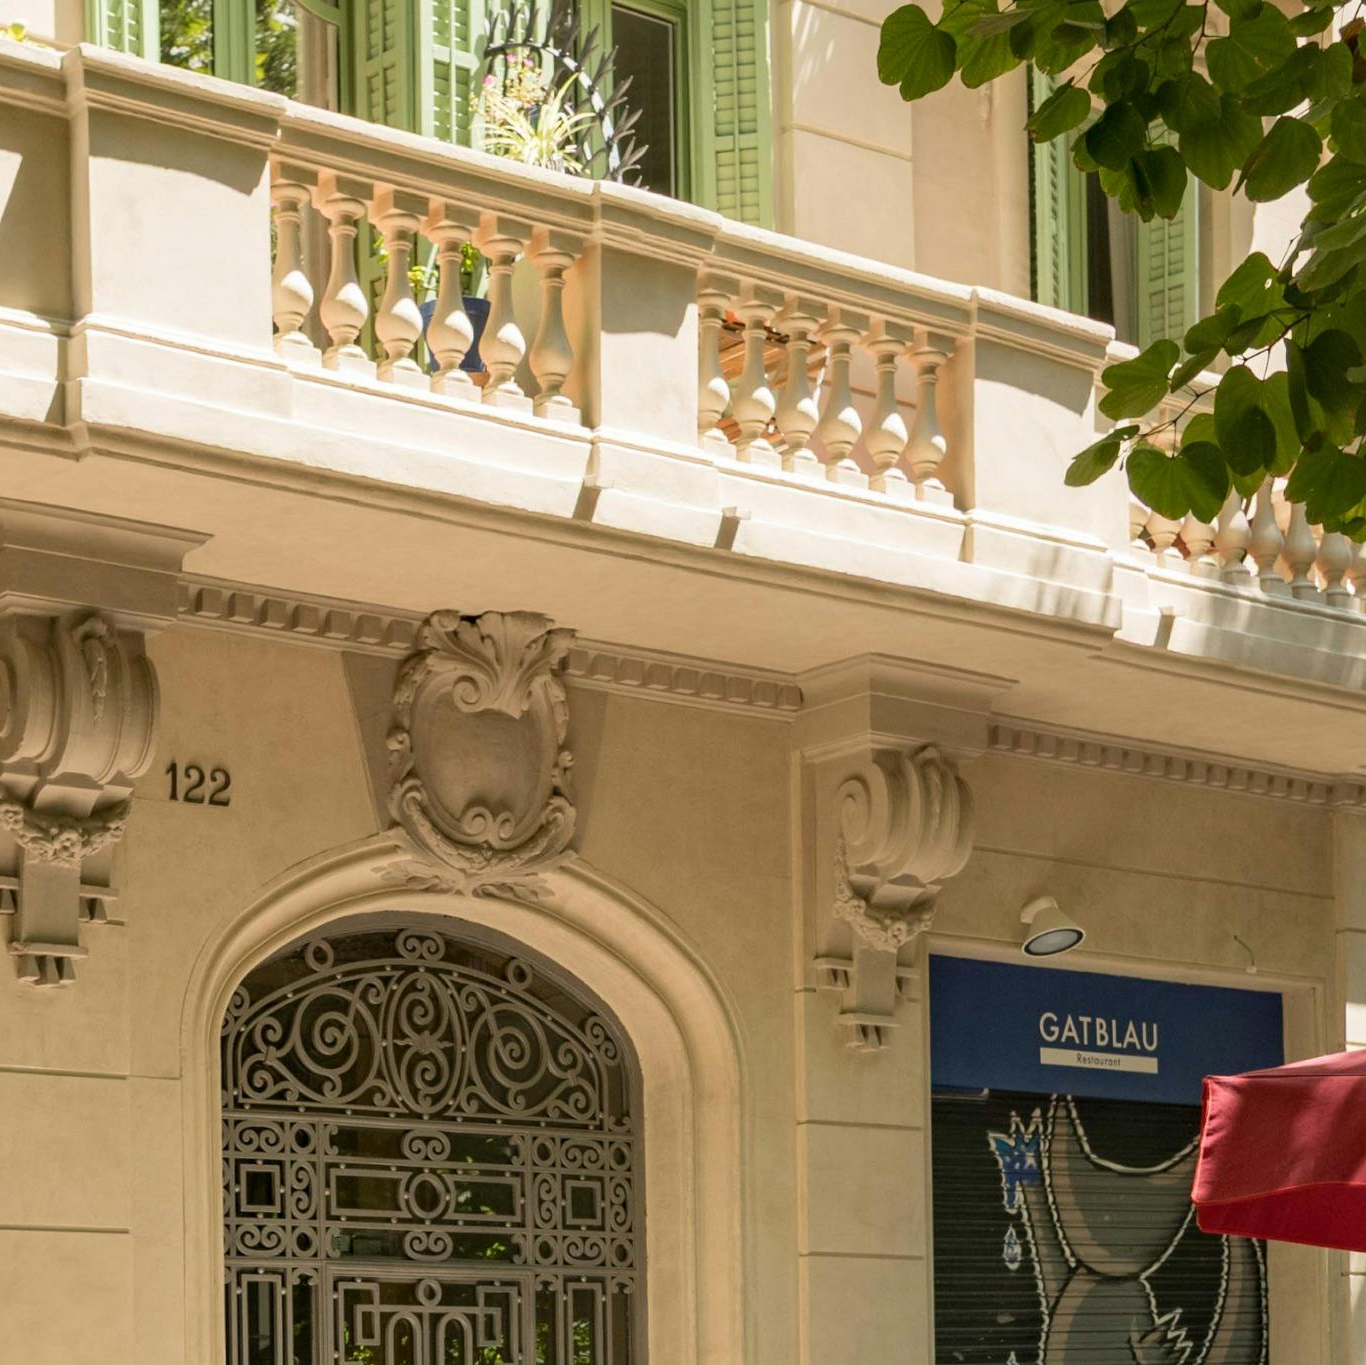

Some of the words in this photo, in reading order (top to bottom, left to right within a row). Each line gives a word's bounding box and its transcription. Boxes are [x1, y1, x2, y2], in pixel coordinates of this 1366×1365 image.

[165, 761, 231, 807] 122
[1039, 1012, 1157, 1051] GATBLAU
[1076, 1052, 1122, 1067] Restaurant
